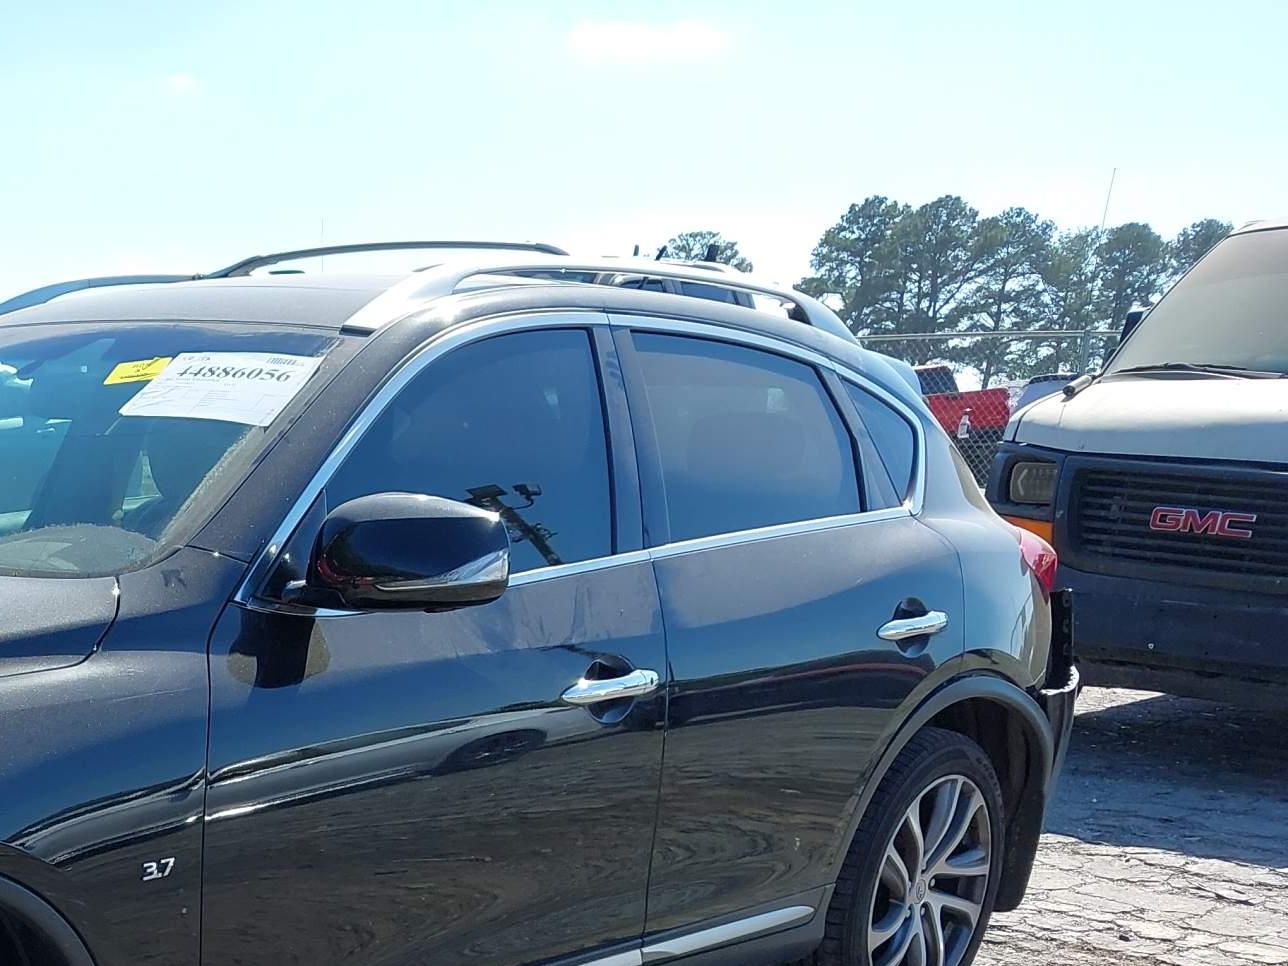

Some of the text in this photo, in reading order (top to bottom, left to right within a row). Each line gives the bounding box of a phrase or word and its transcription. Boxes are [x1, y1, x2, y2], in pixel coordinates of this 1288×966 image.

[177, 365, 296, 382] 44886056
[1149, 506, 1257, 538] GMC
[142, 856, 176, 881] 3.7
